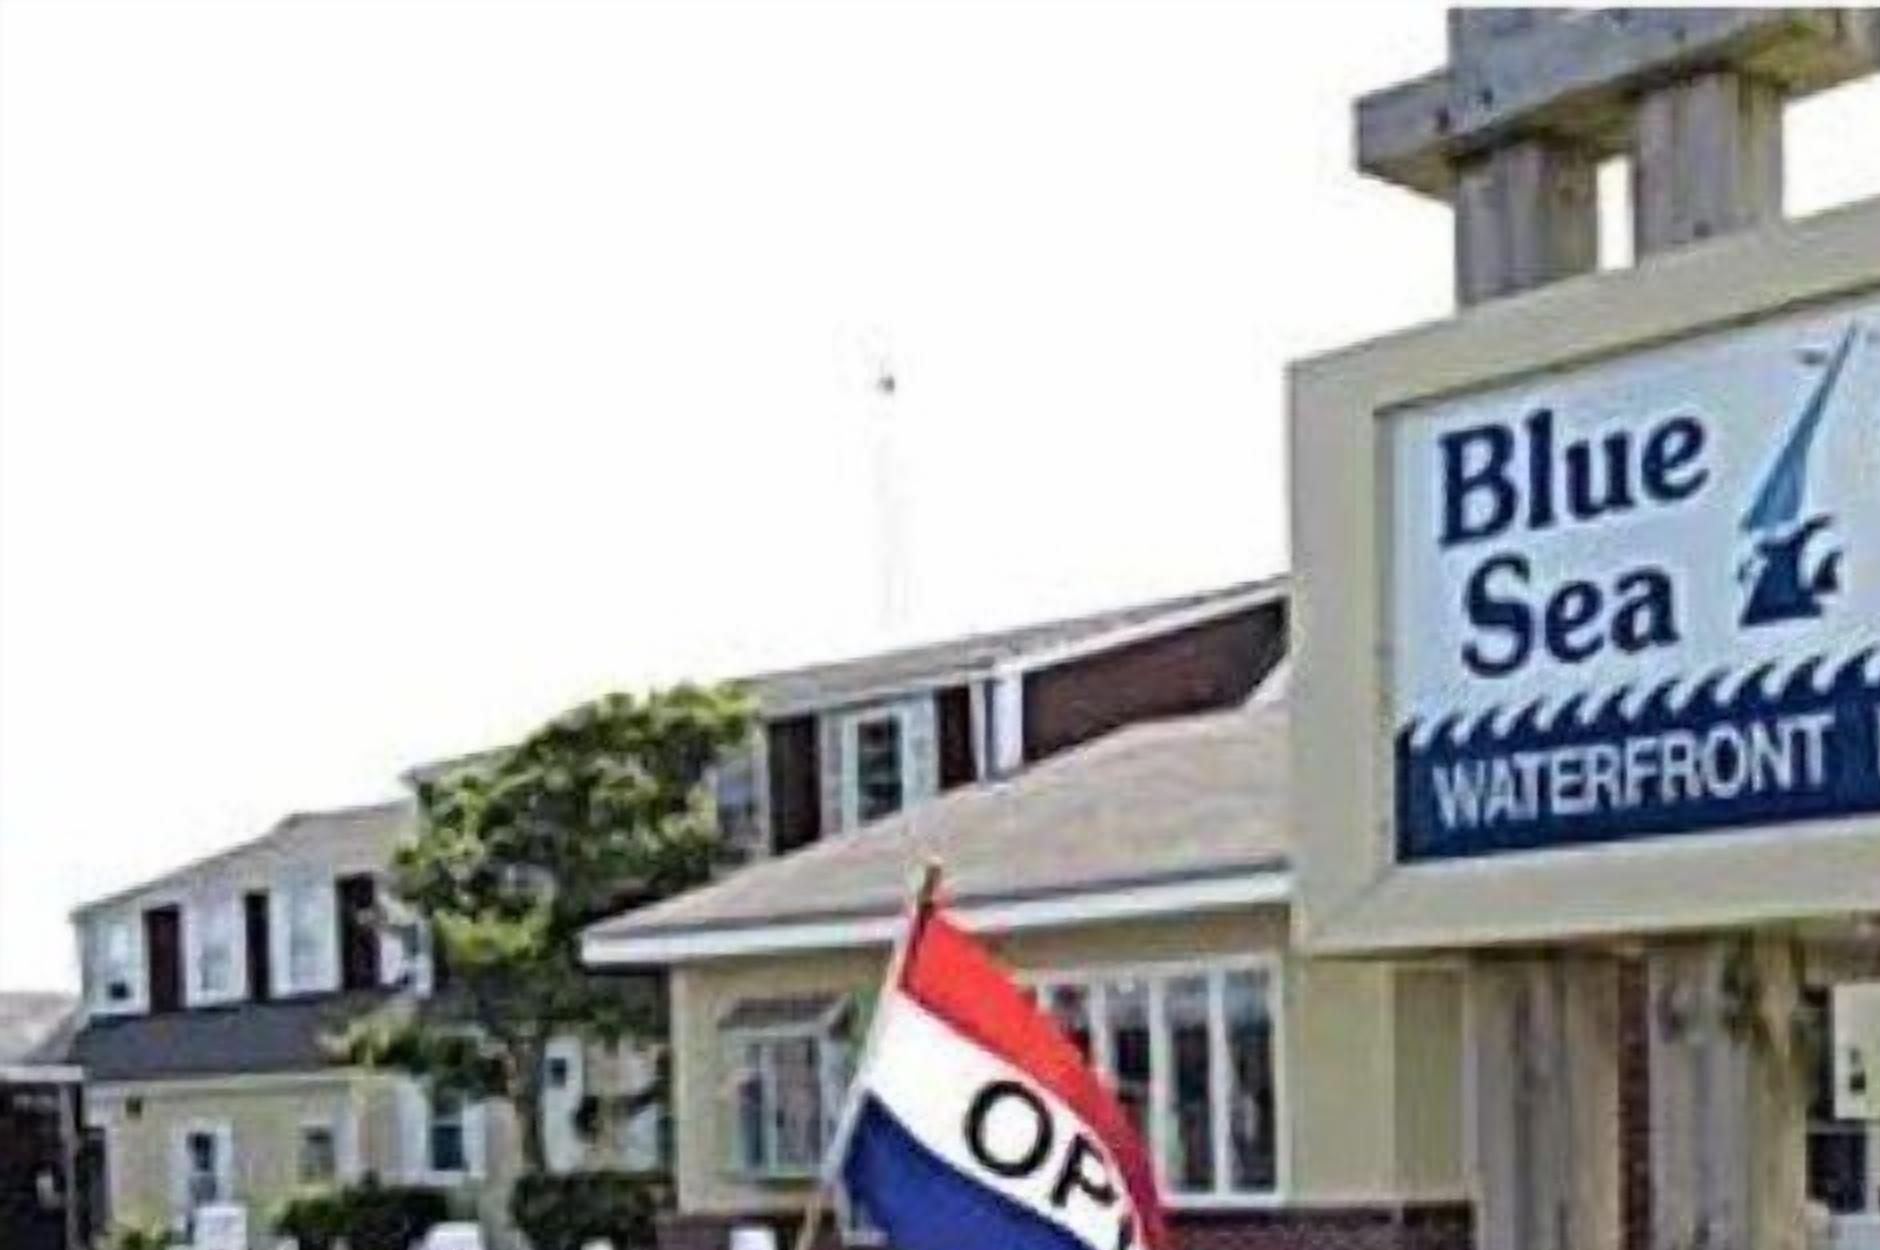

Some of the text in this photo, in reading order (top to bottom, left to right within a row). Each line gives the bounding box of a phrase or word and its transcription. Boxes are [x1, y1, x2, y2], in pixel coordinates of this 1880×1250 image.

[1439, 408, 1710, 548] Blue
[1461, 553, 1680, 678] Sea
[1433, 713, 1837, 831] WATERFRONT
